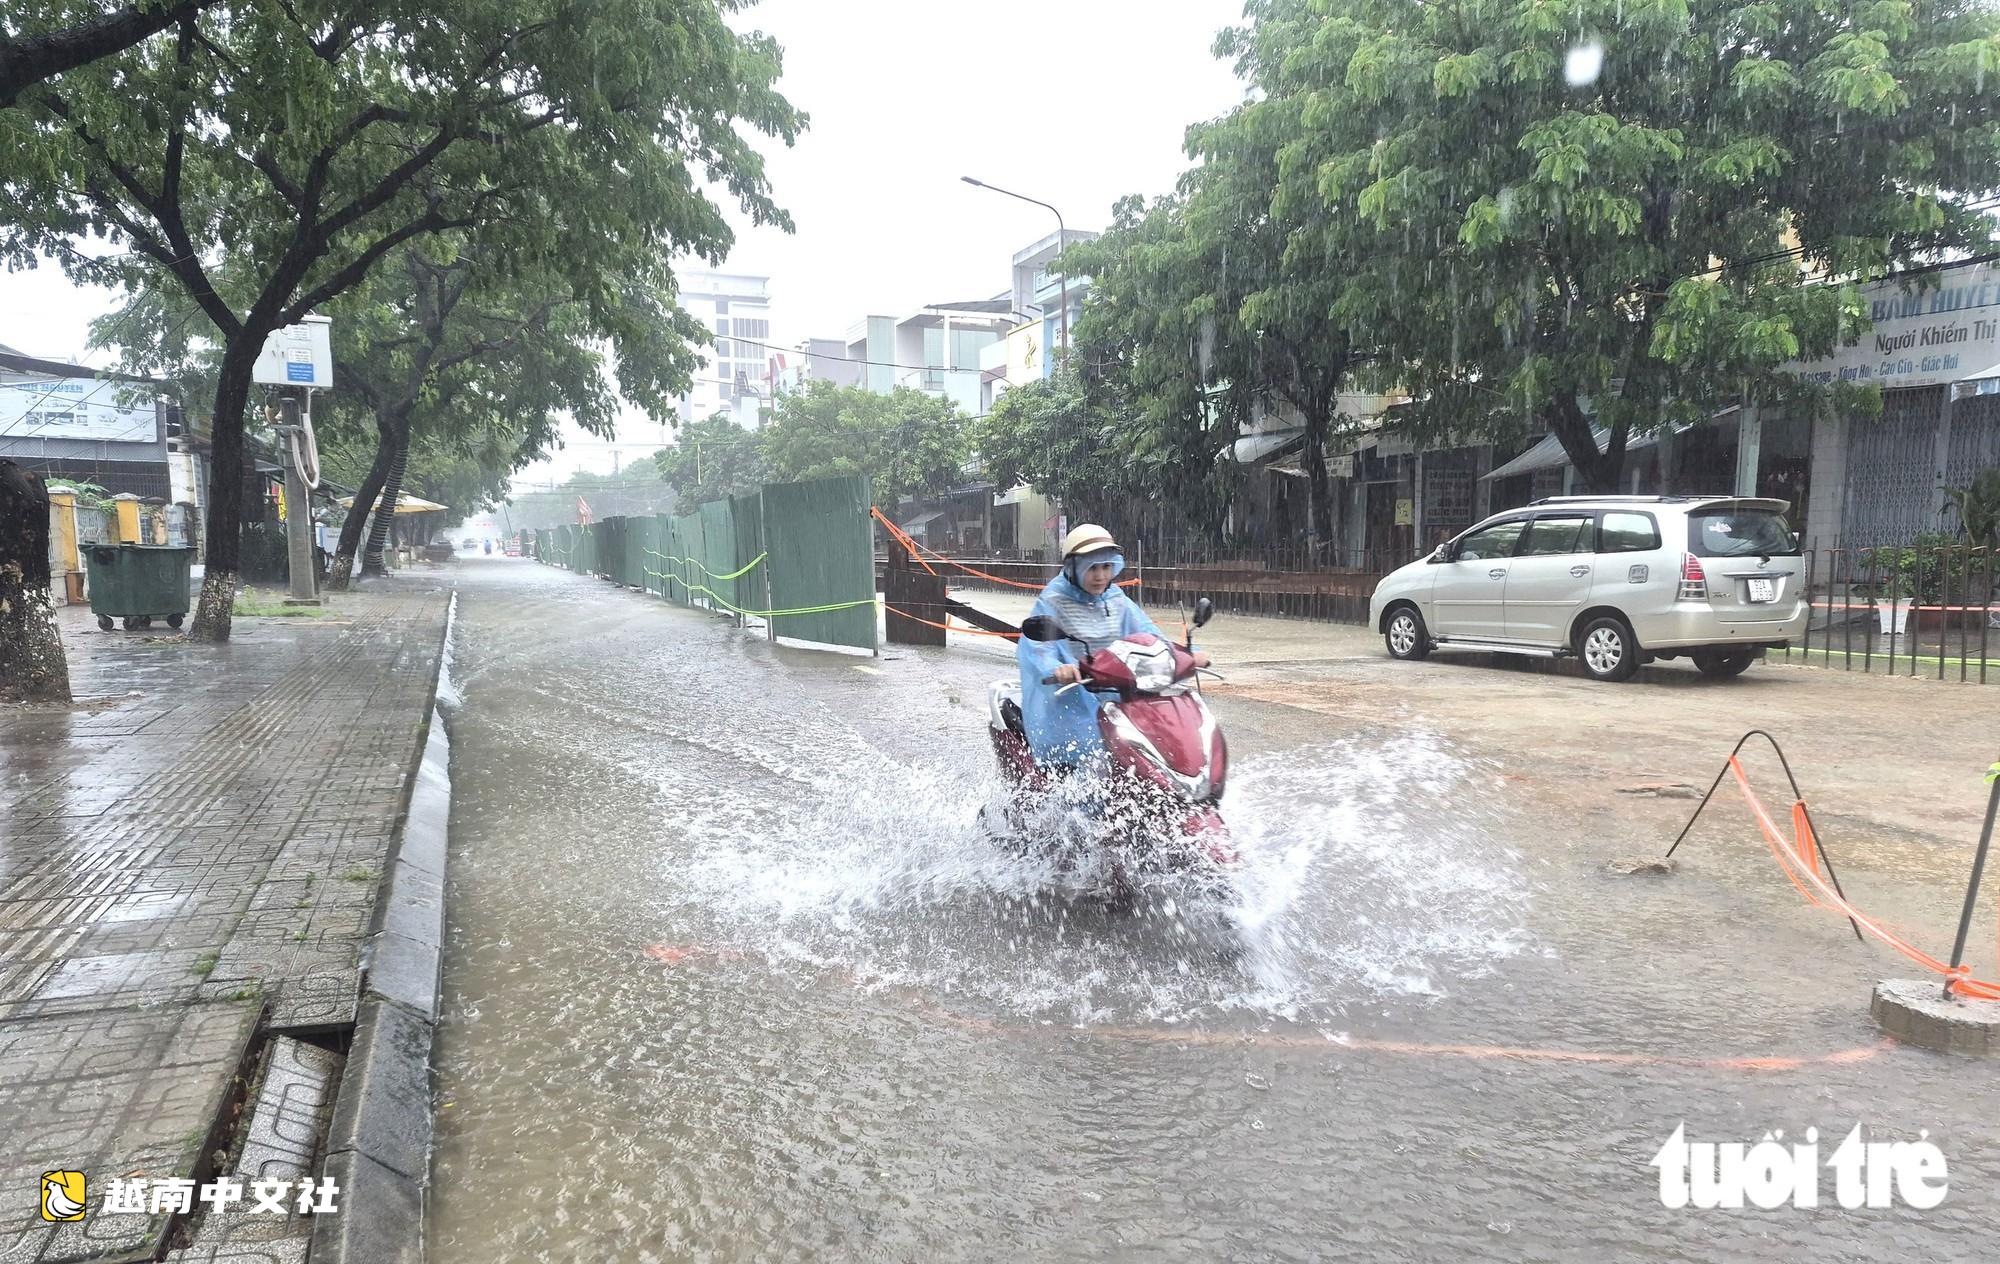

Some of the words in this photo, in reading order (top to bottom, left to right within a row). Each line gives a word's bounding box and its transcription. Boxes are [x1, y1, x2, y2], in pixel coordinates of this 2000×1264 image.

[1875, 329, 1917, 355] Người
[1920, 321, 1968, 347] Khiếm
[1974, 319, 1998, 344] Thị
